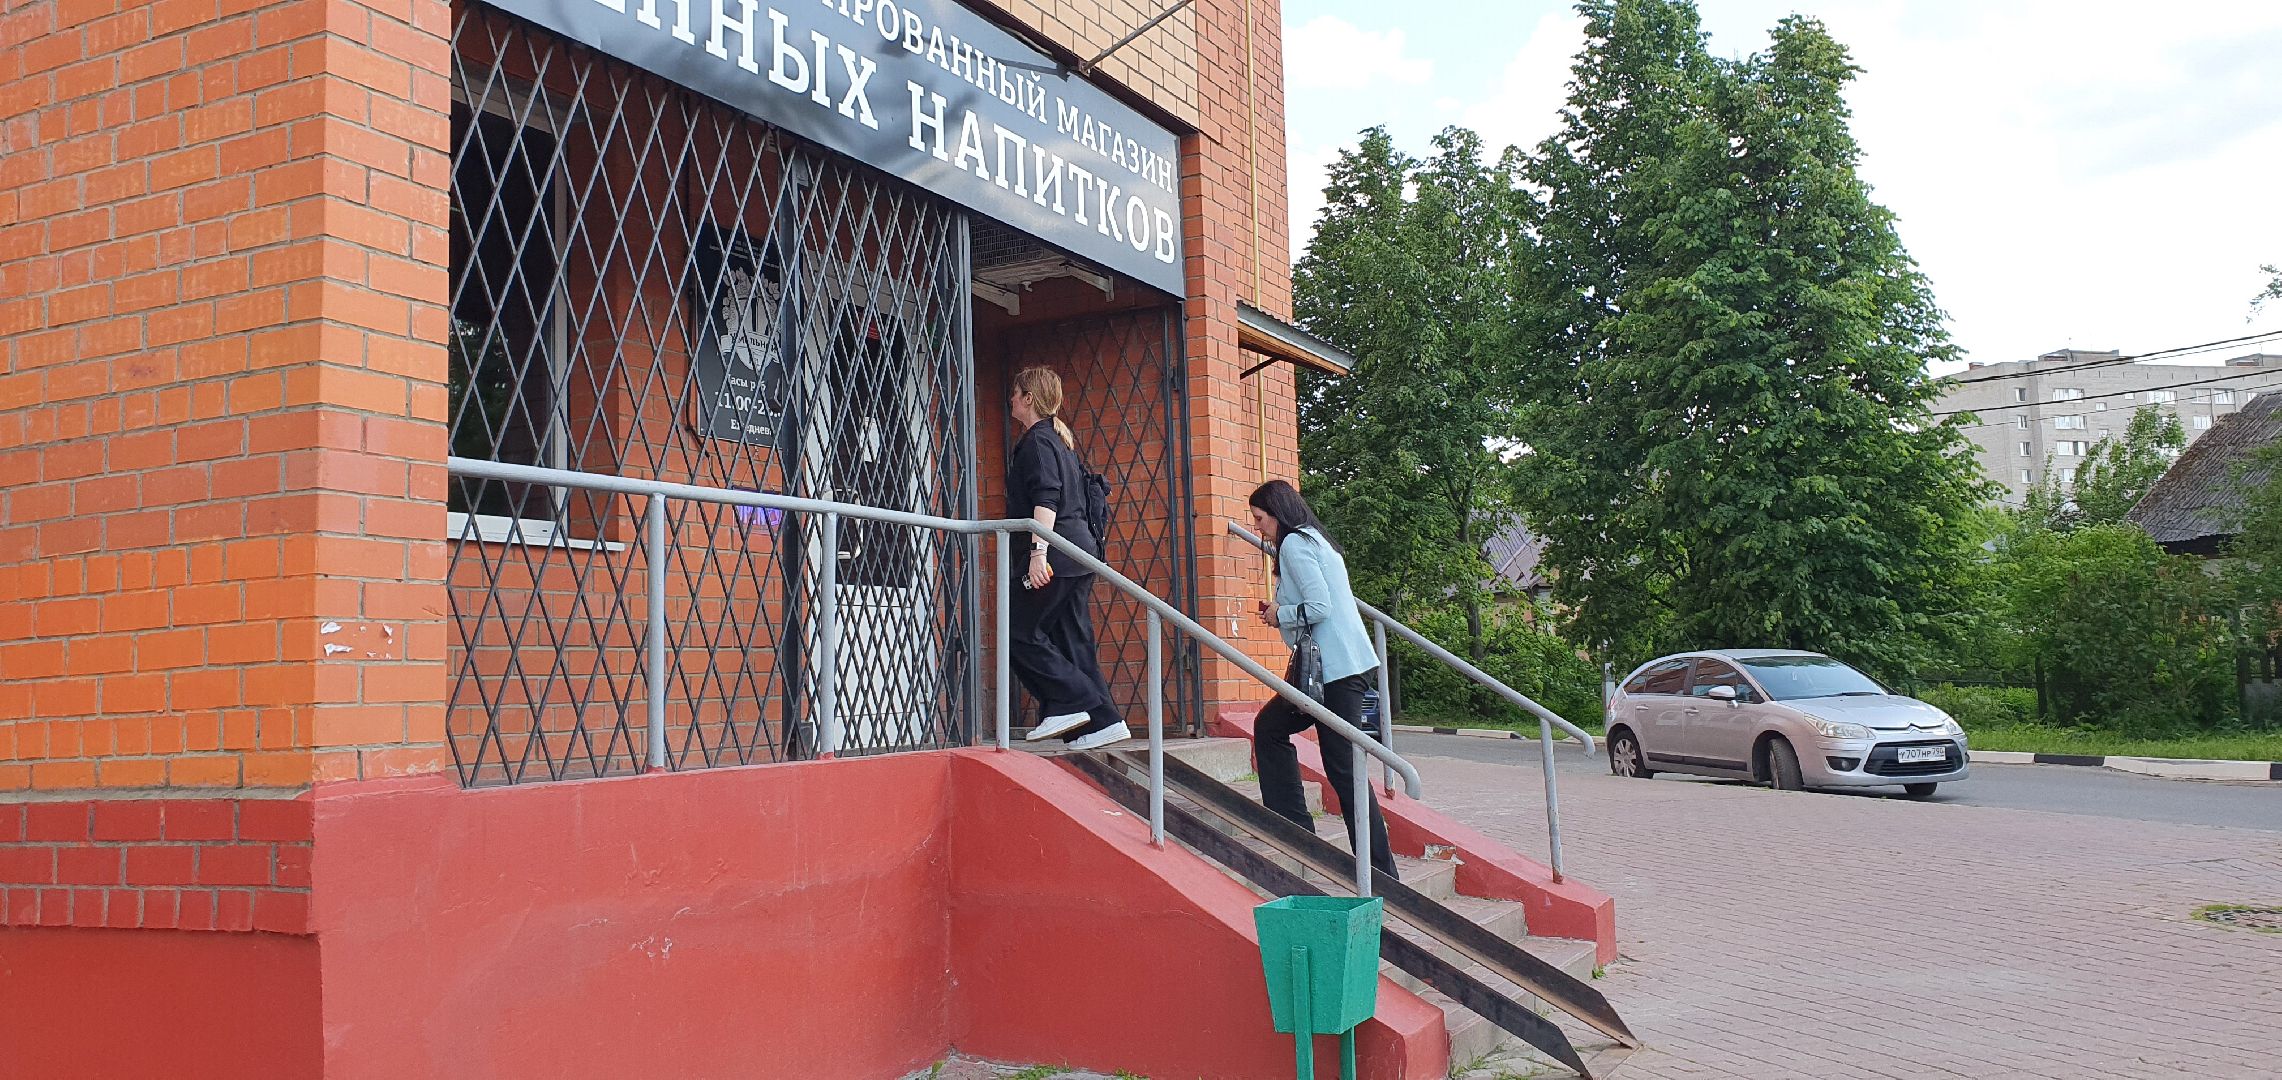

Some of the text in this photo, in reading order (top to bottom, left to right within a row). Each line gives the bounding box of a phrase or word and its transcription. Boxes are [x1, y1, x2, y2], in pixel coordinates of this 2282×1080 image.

[594, 0, 1176, 264] НЫХ НАПИТКОВ
[822, 0, 1173, 193] РОВАННЫЙ МАГАЗИН
